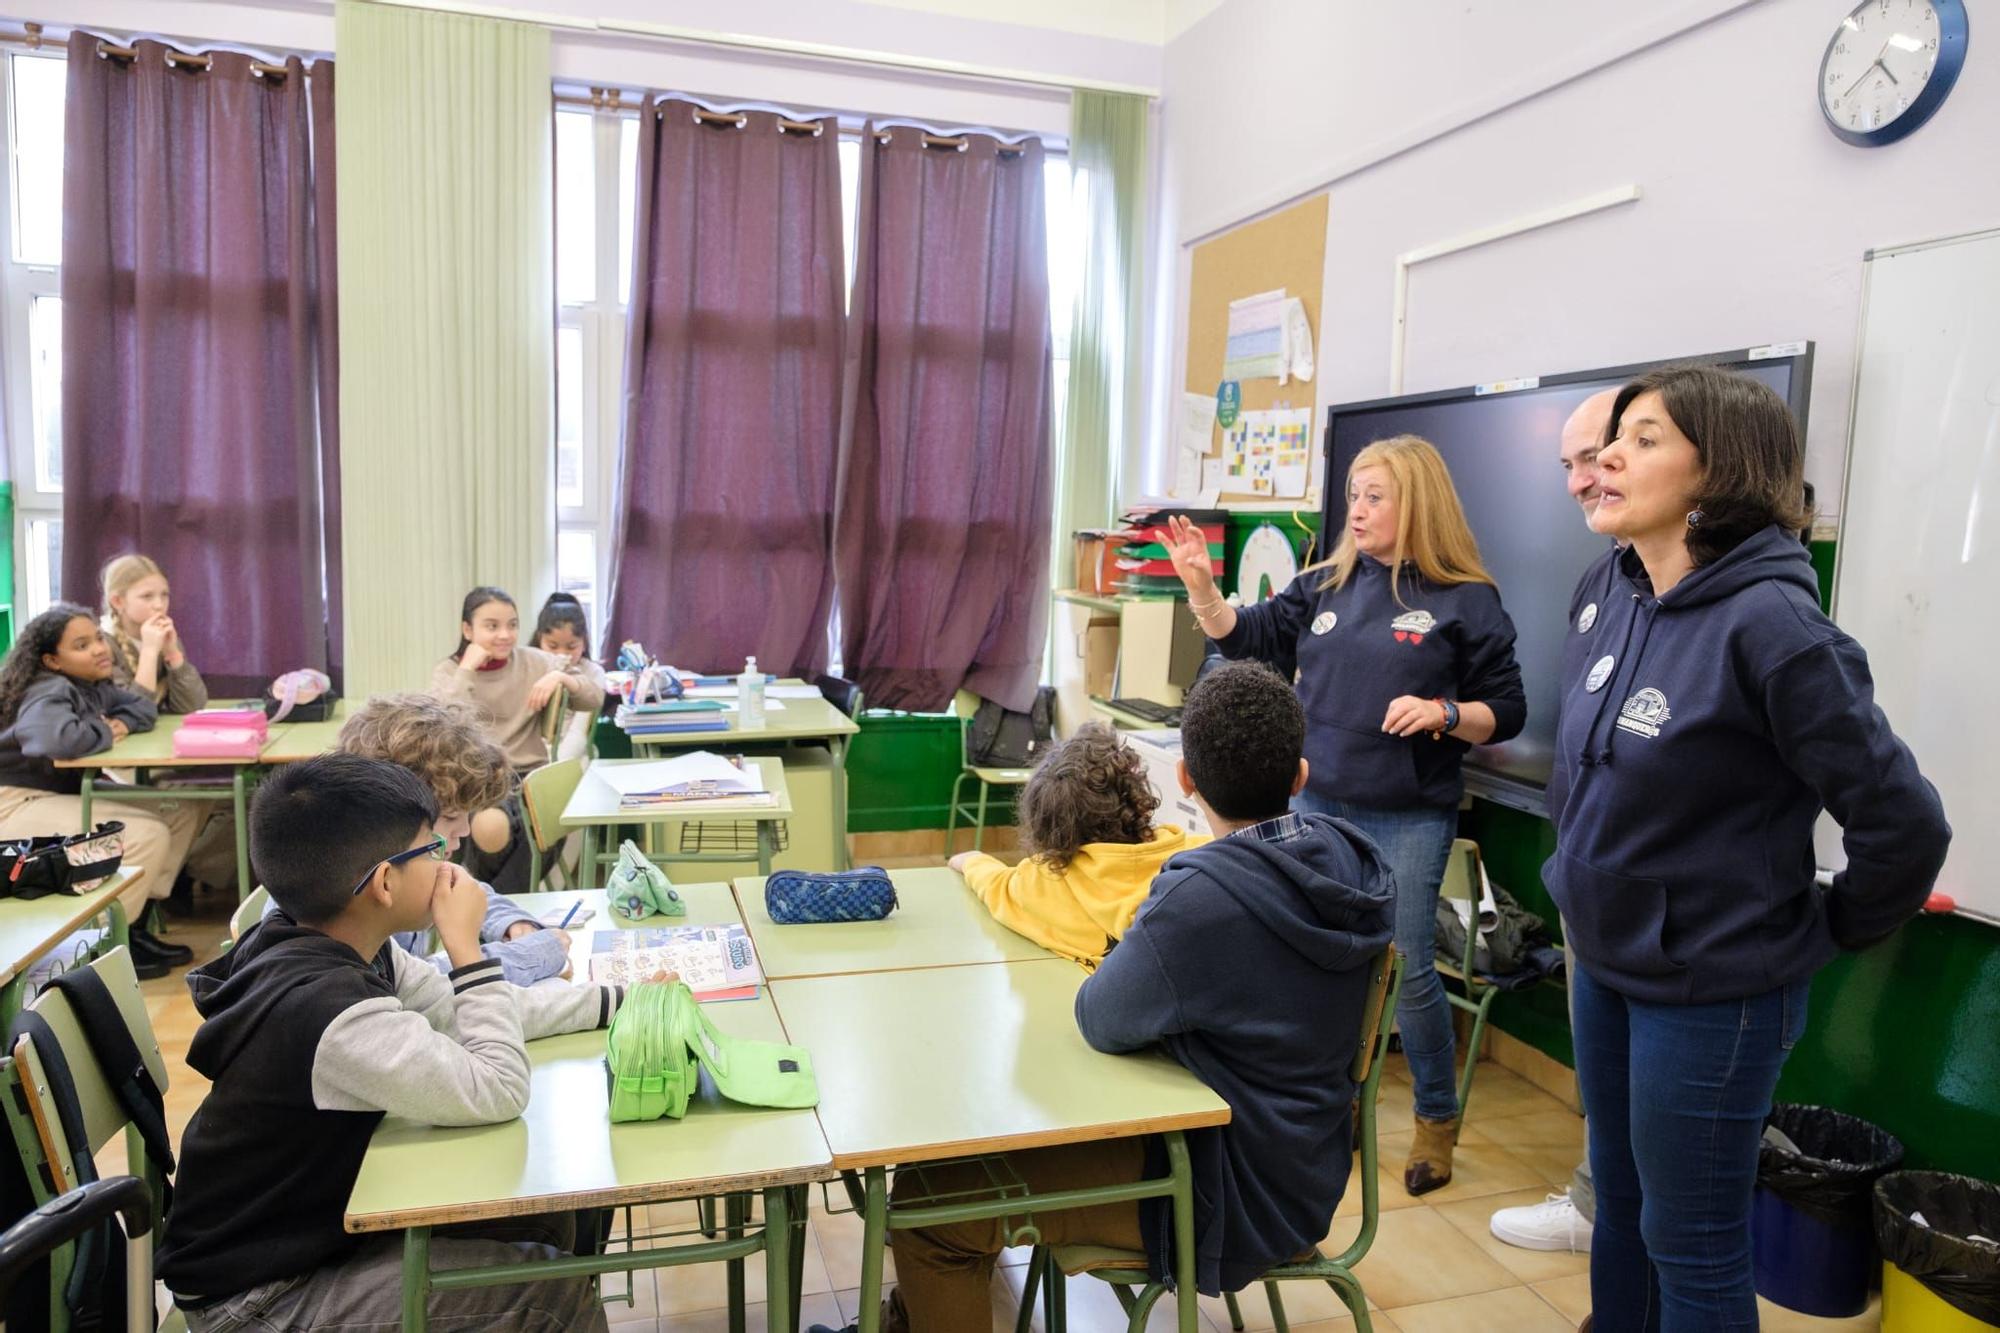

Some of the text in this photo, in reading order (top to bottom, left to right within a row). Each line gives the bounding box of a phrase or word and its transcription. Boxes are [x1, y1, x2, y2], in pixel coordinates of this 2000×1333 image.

[1925, 9, 1932, 20] 2
[1835, 43, 1846, 55] 10
[1930, 38, 1937, 50] 3
[1829, 74, 1835, 85] 9
[1922, 71, 1929, 81] 4
[1833, 99, 1840, 110] 8
[1850, 114, 1856, 125] 7
[1874, 115, 1880, 125] 6
